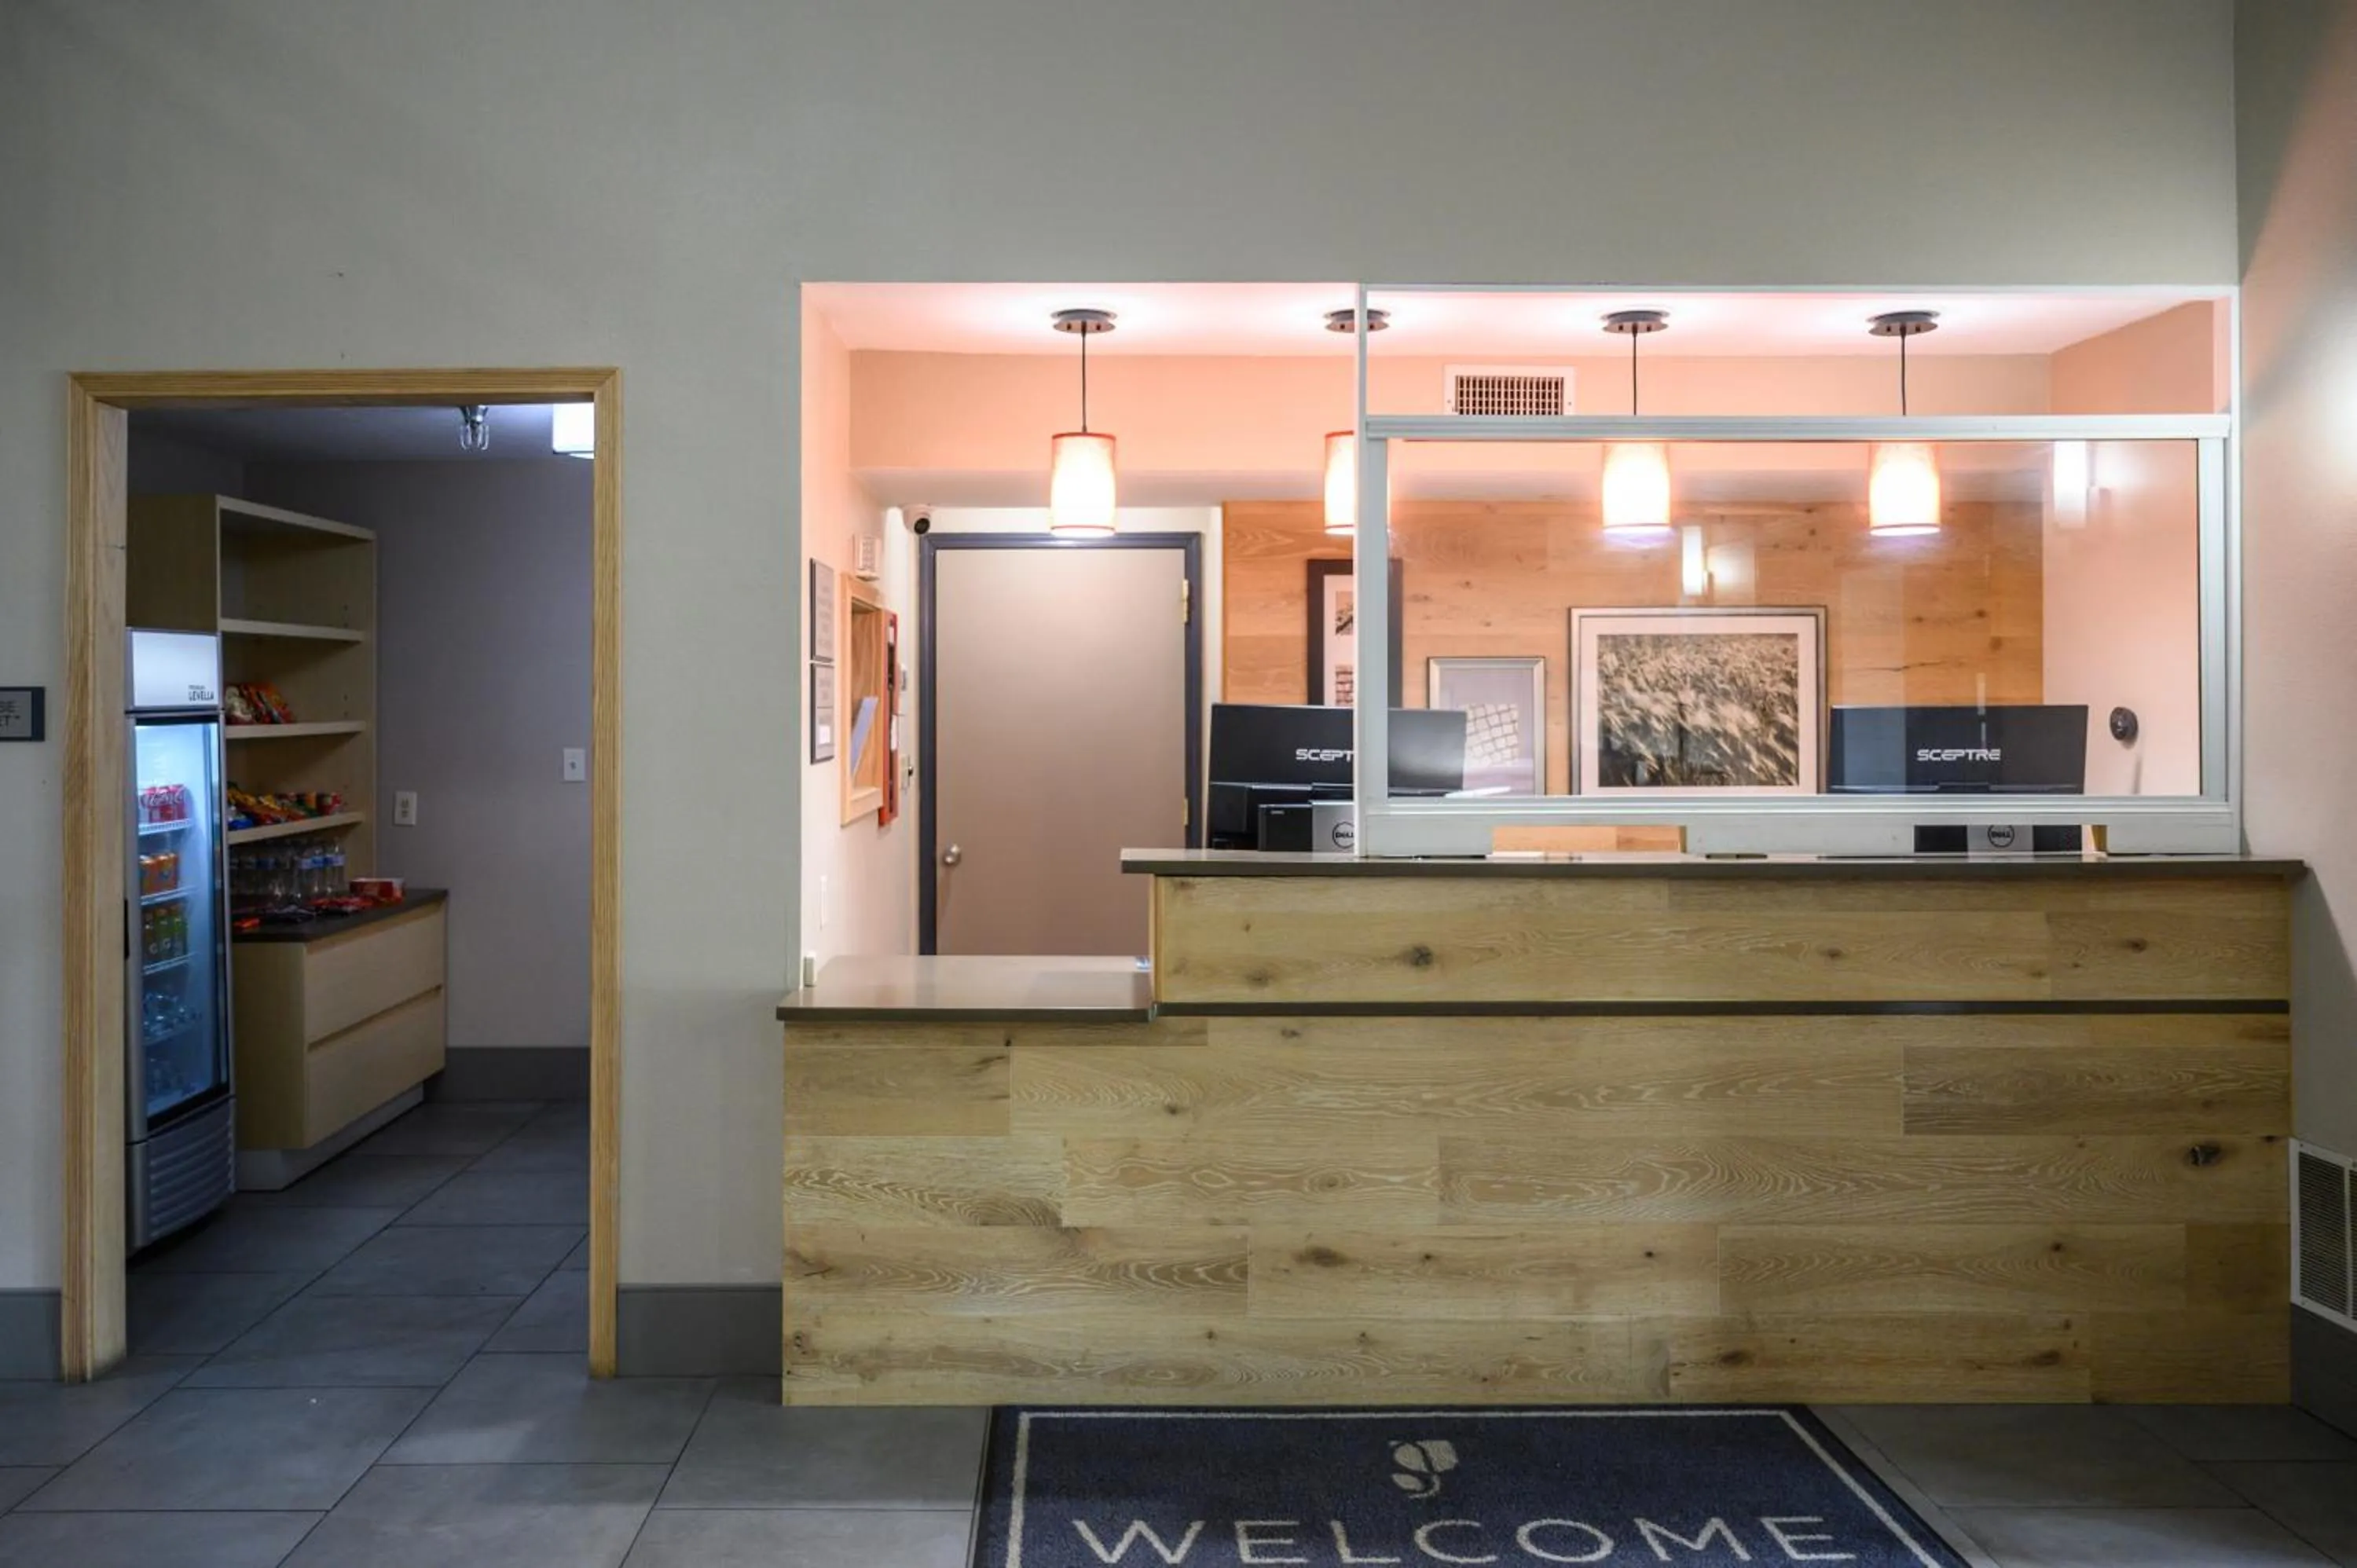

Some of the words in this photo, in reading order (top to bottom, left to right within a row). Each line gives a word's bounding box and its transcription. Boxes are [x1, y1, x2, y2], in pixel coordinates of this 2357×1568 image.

[1296, 749, 1354, 761] SCEPT
[1917, 749, 2001, 761] SCEPTRE
[1072, 1517, 1857, 1564] WELCOME
